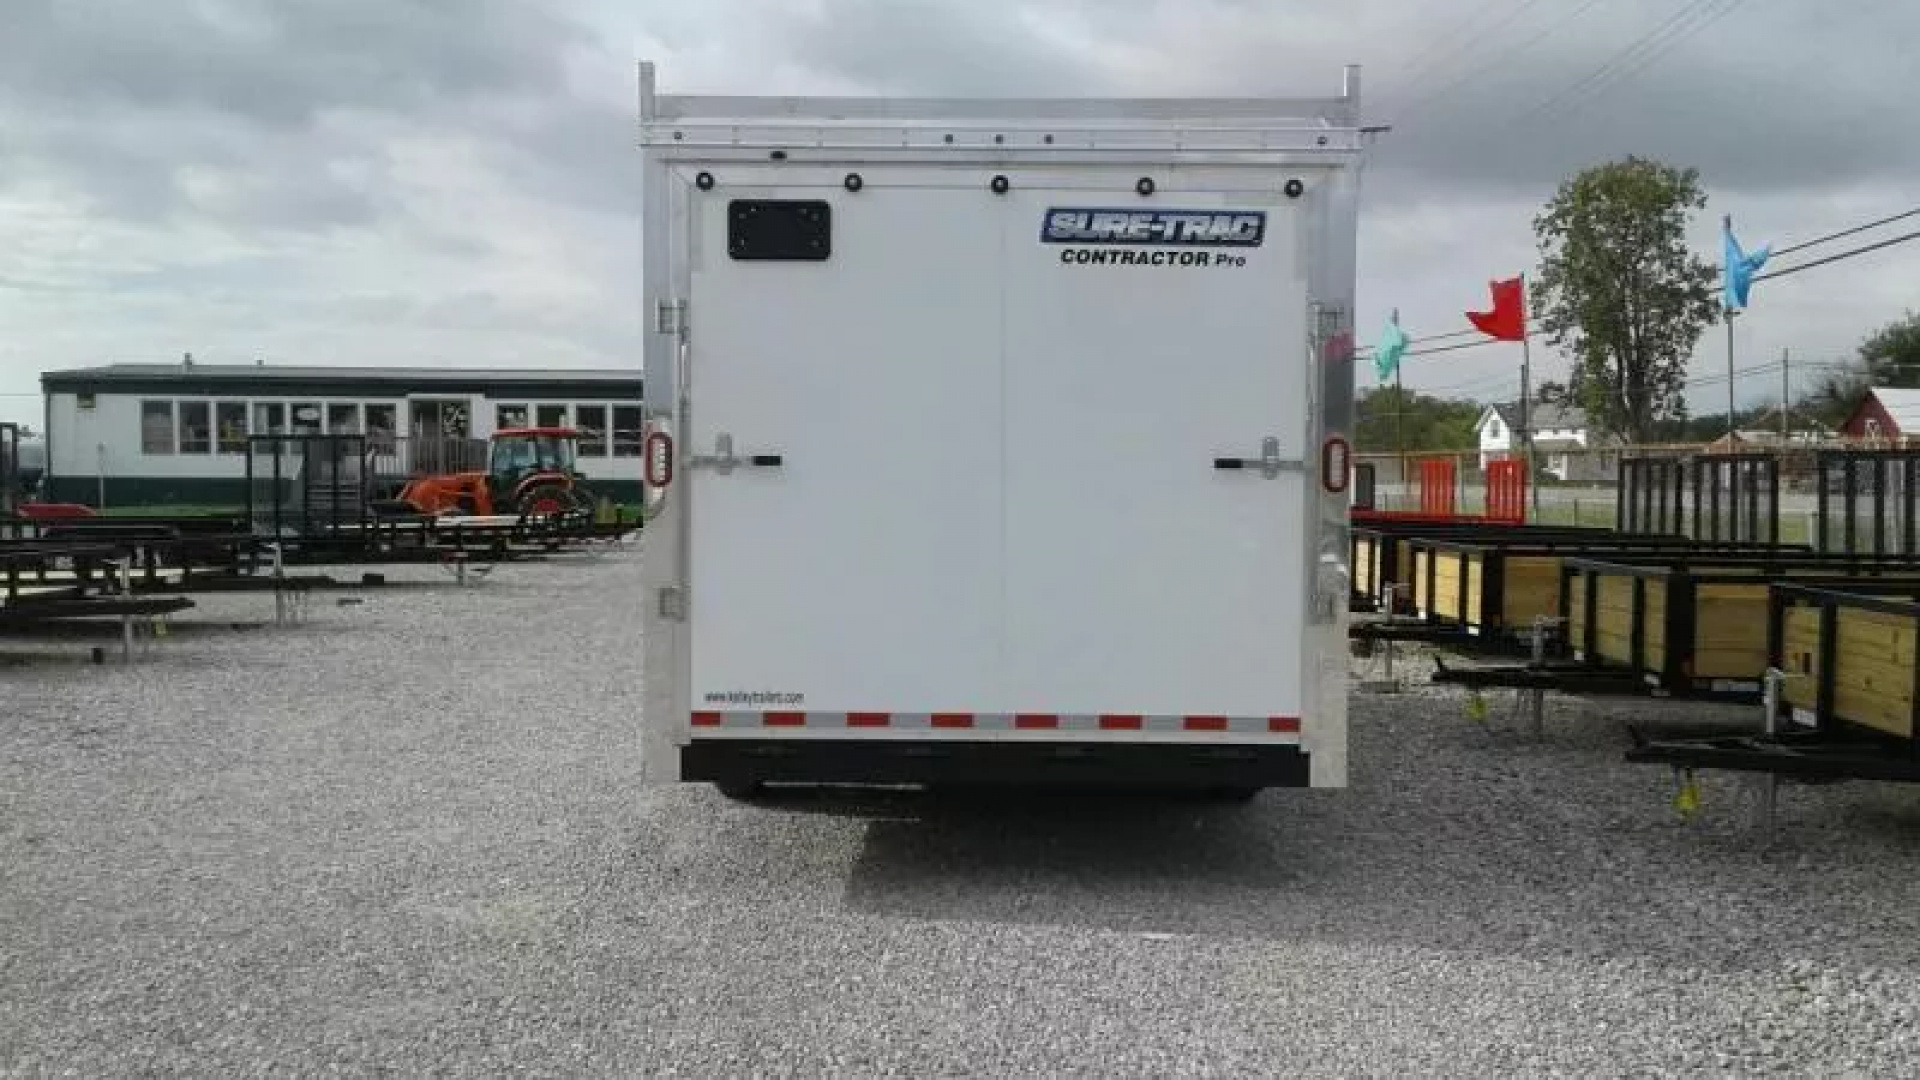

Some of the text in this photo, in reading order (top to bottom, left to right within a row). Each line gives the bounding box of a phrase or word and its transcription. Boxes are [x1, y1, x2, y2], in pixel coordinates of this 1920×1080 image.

[1049, 212, 1261, 242] SURE-TRAC
[1061, 250, 1247, 267] CONTRACTOR Pro
